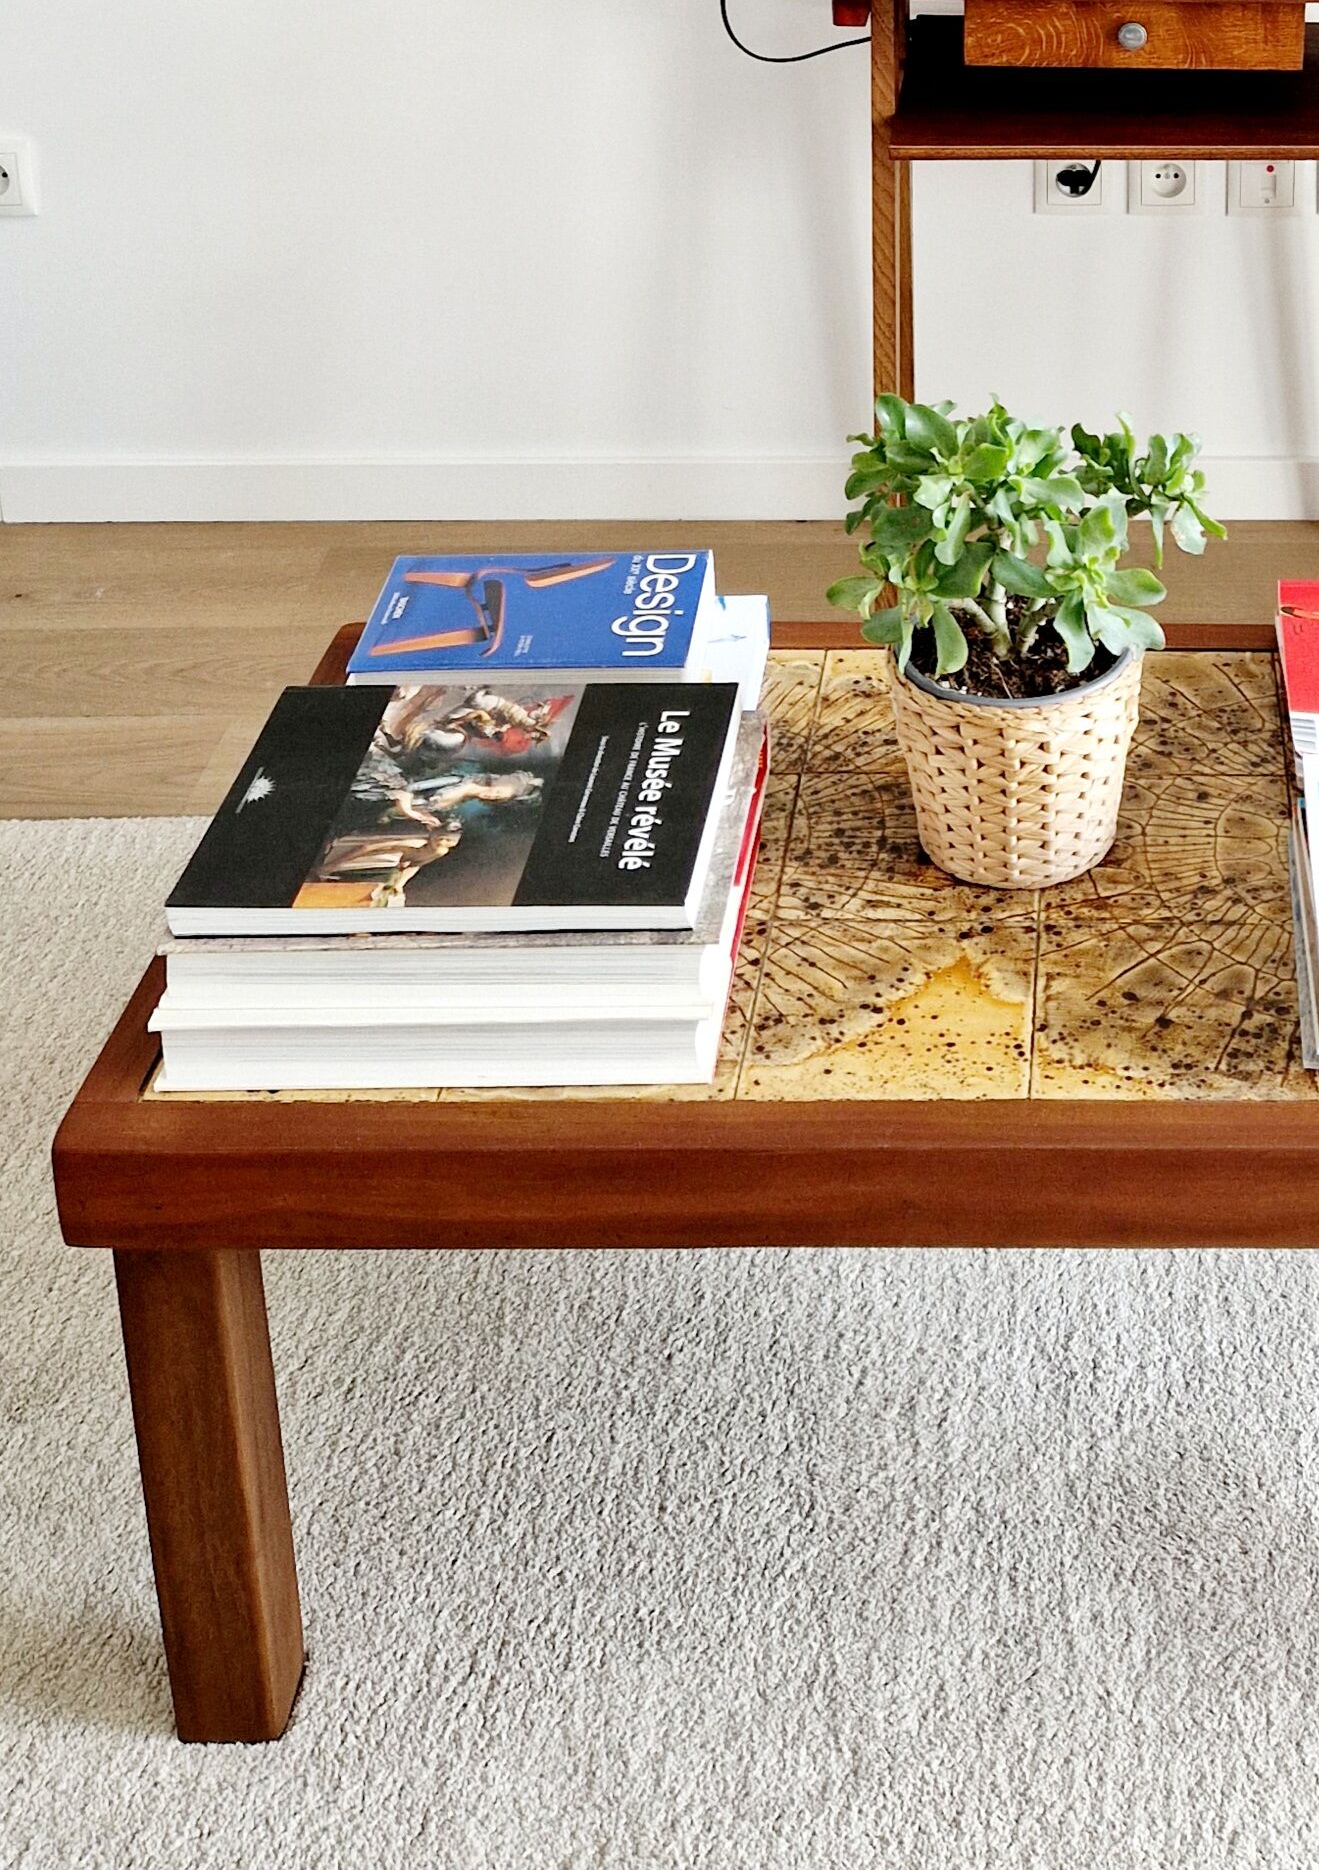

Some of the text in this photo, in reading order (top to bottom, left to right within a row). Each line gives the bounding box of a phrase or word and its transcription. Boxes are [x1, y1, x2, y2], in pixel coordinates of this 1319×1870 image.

[611, 554, 697, 657] Design
[600, 825, 617, 857] VERSAILLES
[618, 710, 691, 870] Le Musée révélé
